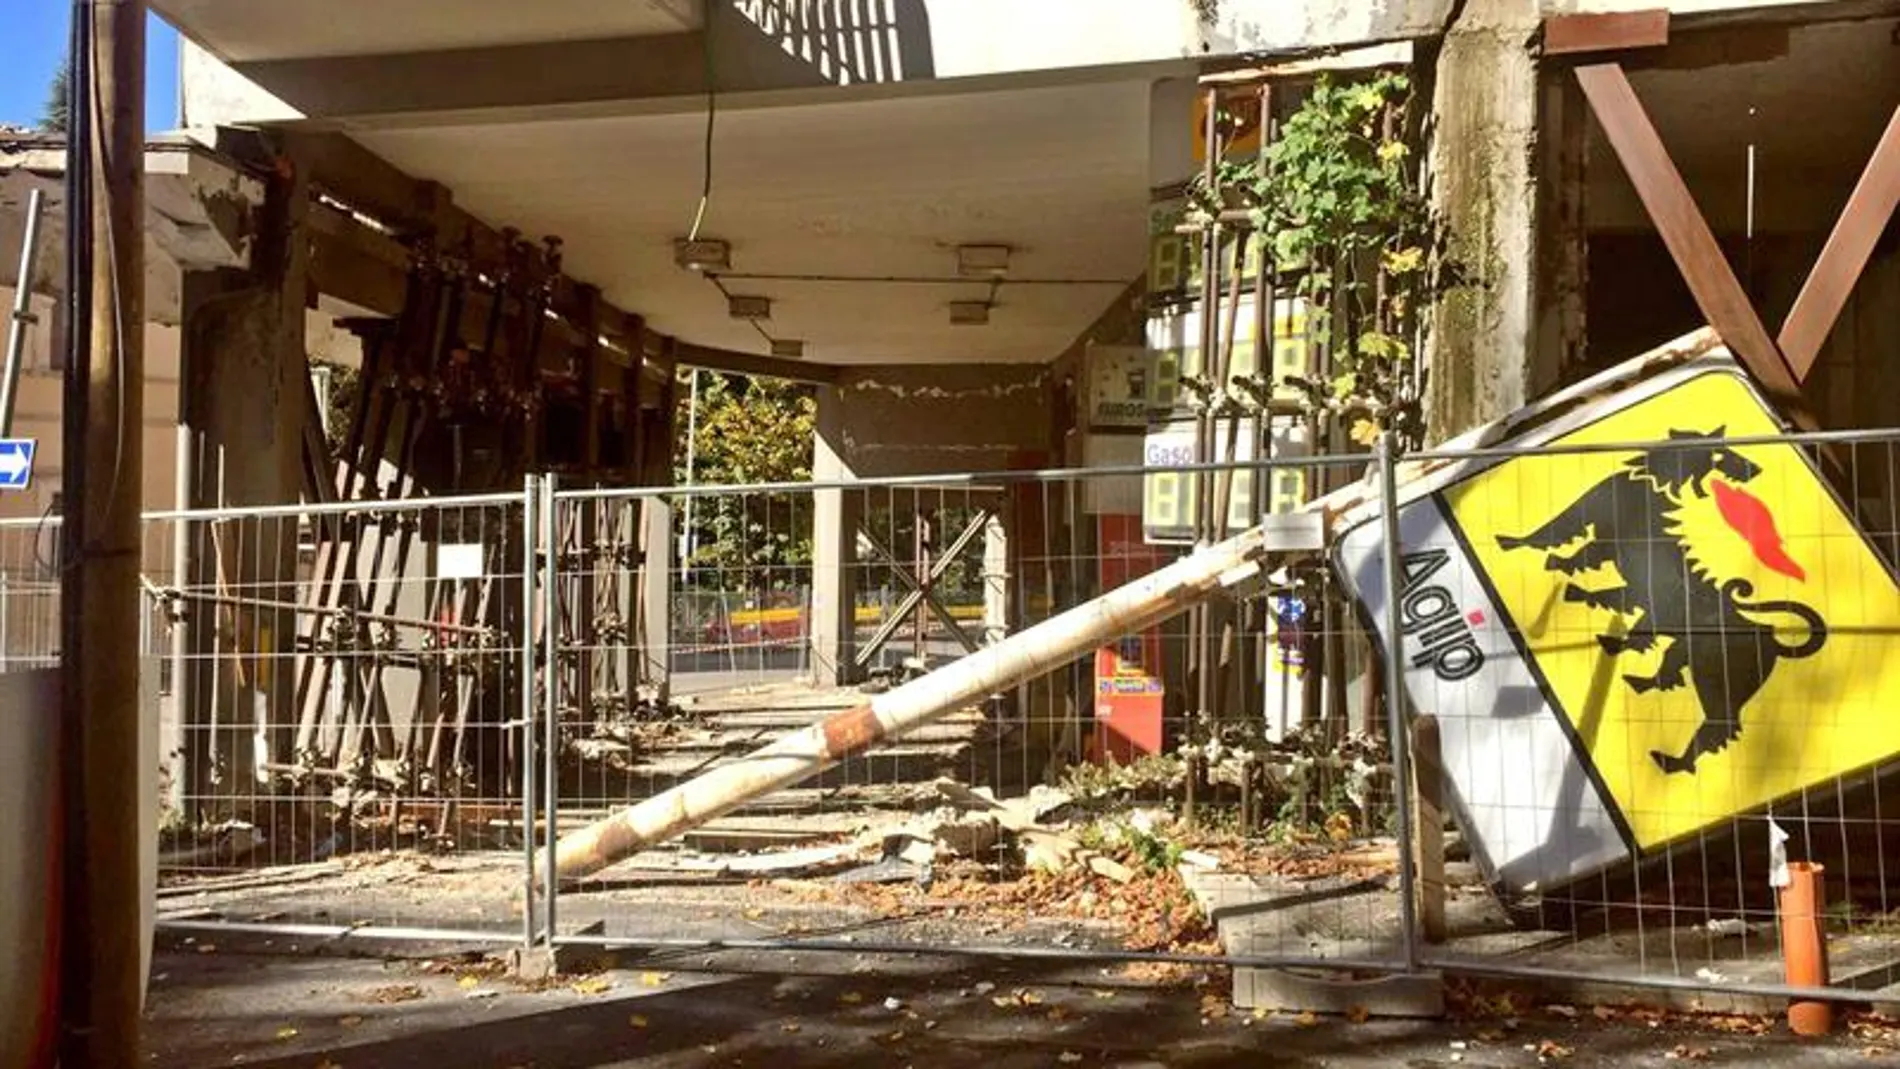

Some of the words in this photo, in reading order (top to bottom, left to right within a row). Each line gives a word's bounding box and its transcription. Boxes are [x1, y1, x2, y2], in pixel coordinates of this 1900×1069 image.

[1098, 403, 1145, 419] EUROS
[1146, 443, 1194, 466] Gaso
[1399, 548, 1485, 681] Agip
